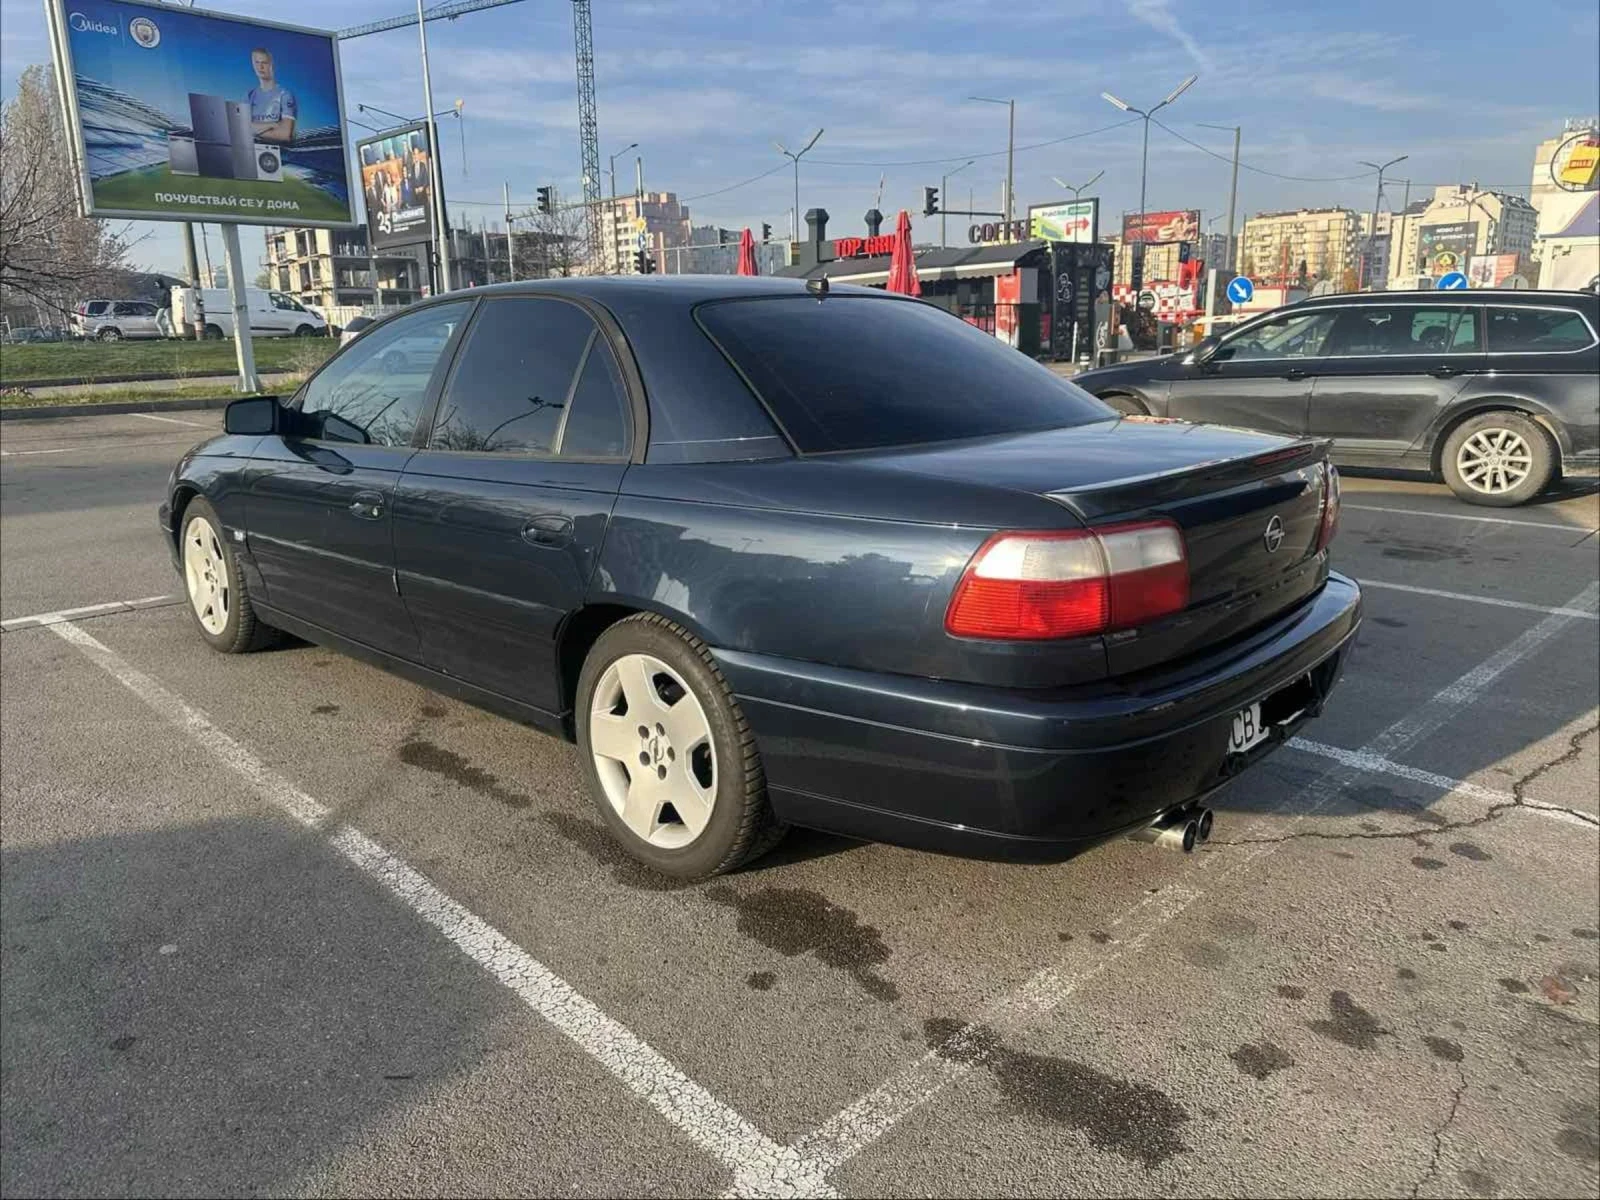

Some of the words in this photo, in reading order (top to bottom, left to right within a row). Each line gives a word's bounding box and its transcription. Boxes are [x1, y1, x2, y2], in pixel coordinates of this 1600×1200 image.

[69, 12, 118, 35] Midea
[155, 192, 237, 207] ПОЧУВСТВАЙ
[239, 198, 255, 207] СЕ
[256, 199, 264, 208] У
[266, 200, 300, 210] ДОМА
[377, 211, 392, 234] 25
[834, 238, 861, 257] TOP
